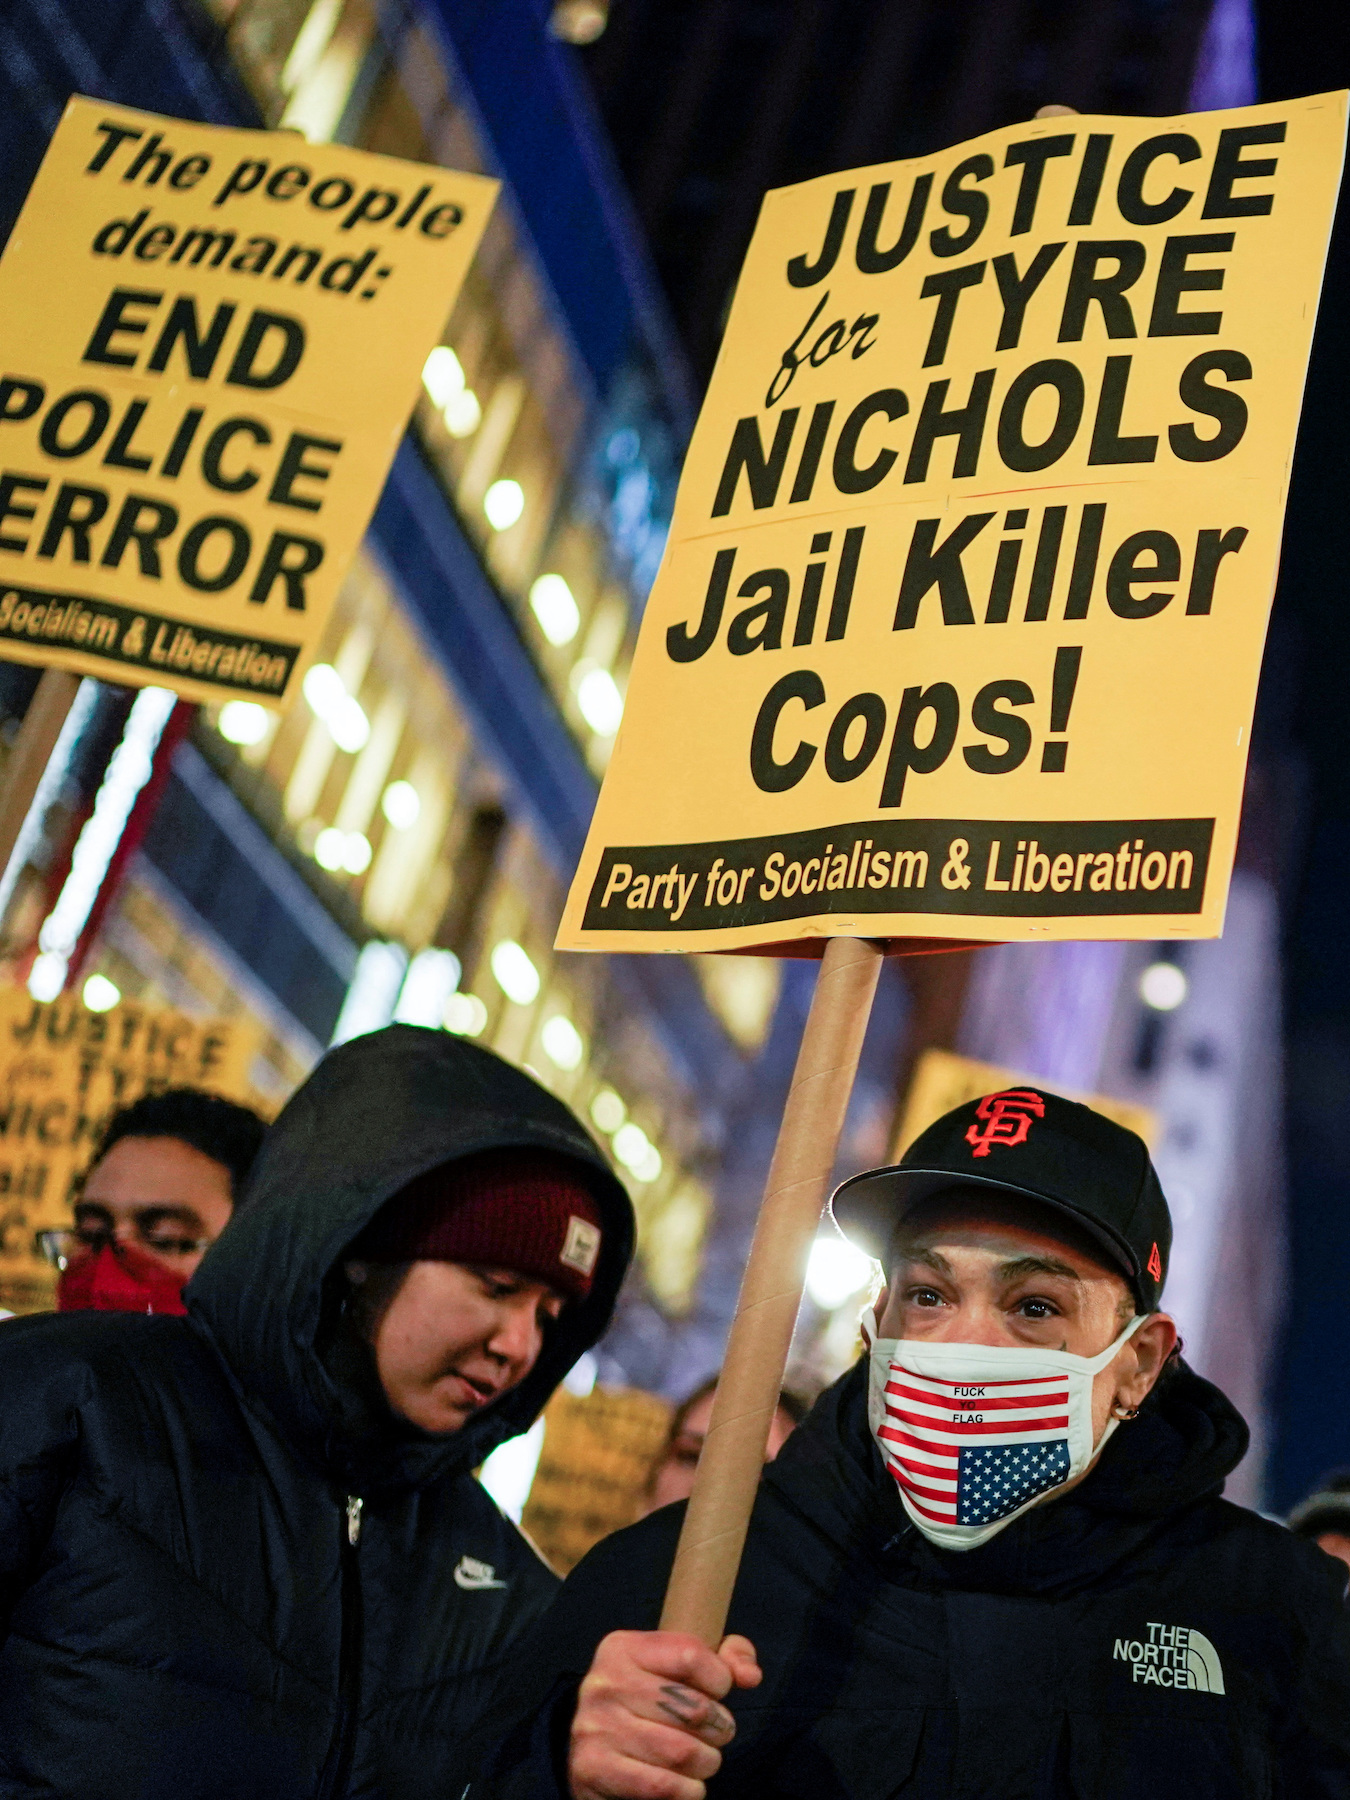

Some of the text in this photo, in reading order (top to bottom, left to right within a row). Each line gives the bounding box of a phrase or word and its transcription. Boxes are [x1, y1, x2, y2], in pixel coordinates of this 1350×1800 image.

[86, 121, 465, 240] The people
[787, 121, 1288, 289] JUSTICE
[92, 208, 394, 300] demand:
[82, 287, 307, 391] END
[765, 232, 1235, 408] for TYRE
[711, 350, 1253, 518] NICHOLS
[666, 502, 1249, 663] Jail Killer
[0, 591, 288, 687] Socialism & Liberation
[749, 646, 1082, 808] Cops!
[600, 838, 1194, 922] Party for Socialism & Liberation
[10, 1002, 224, 1070] JUSTICE
[952, 1413, 984, 1424] FLAG
[953, 1386, 986, 1397] FUCK
[959, 1400, 977, 1411] YO
[1112, 1638, 1188, 1669] NORTH
[1132, 1662, 1188, 1690] FACE
[1146, 1622, 1190, 1648] THE
